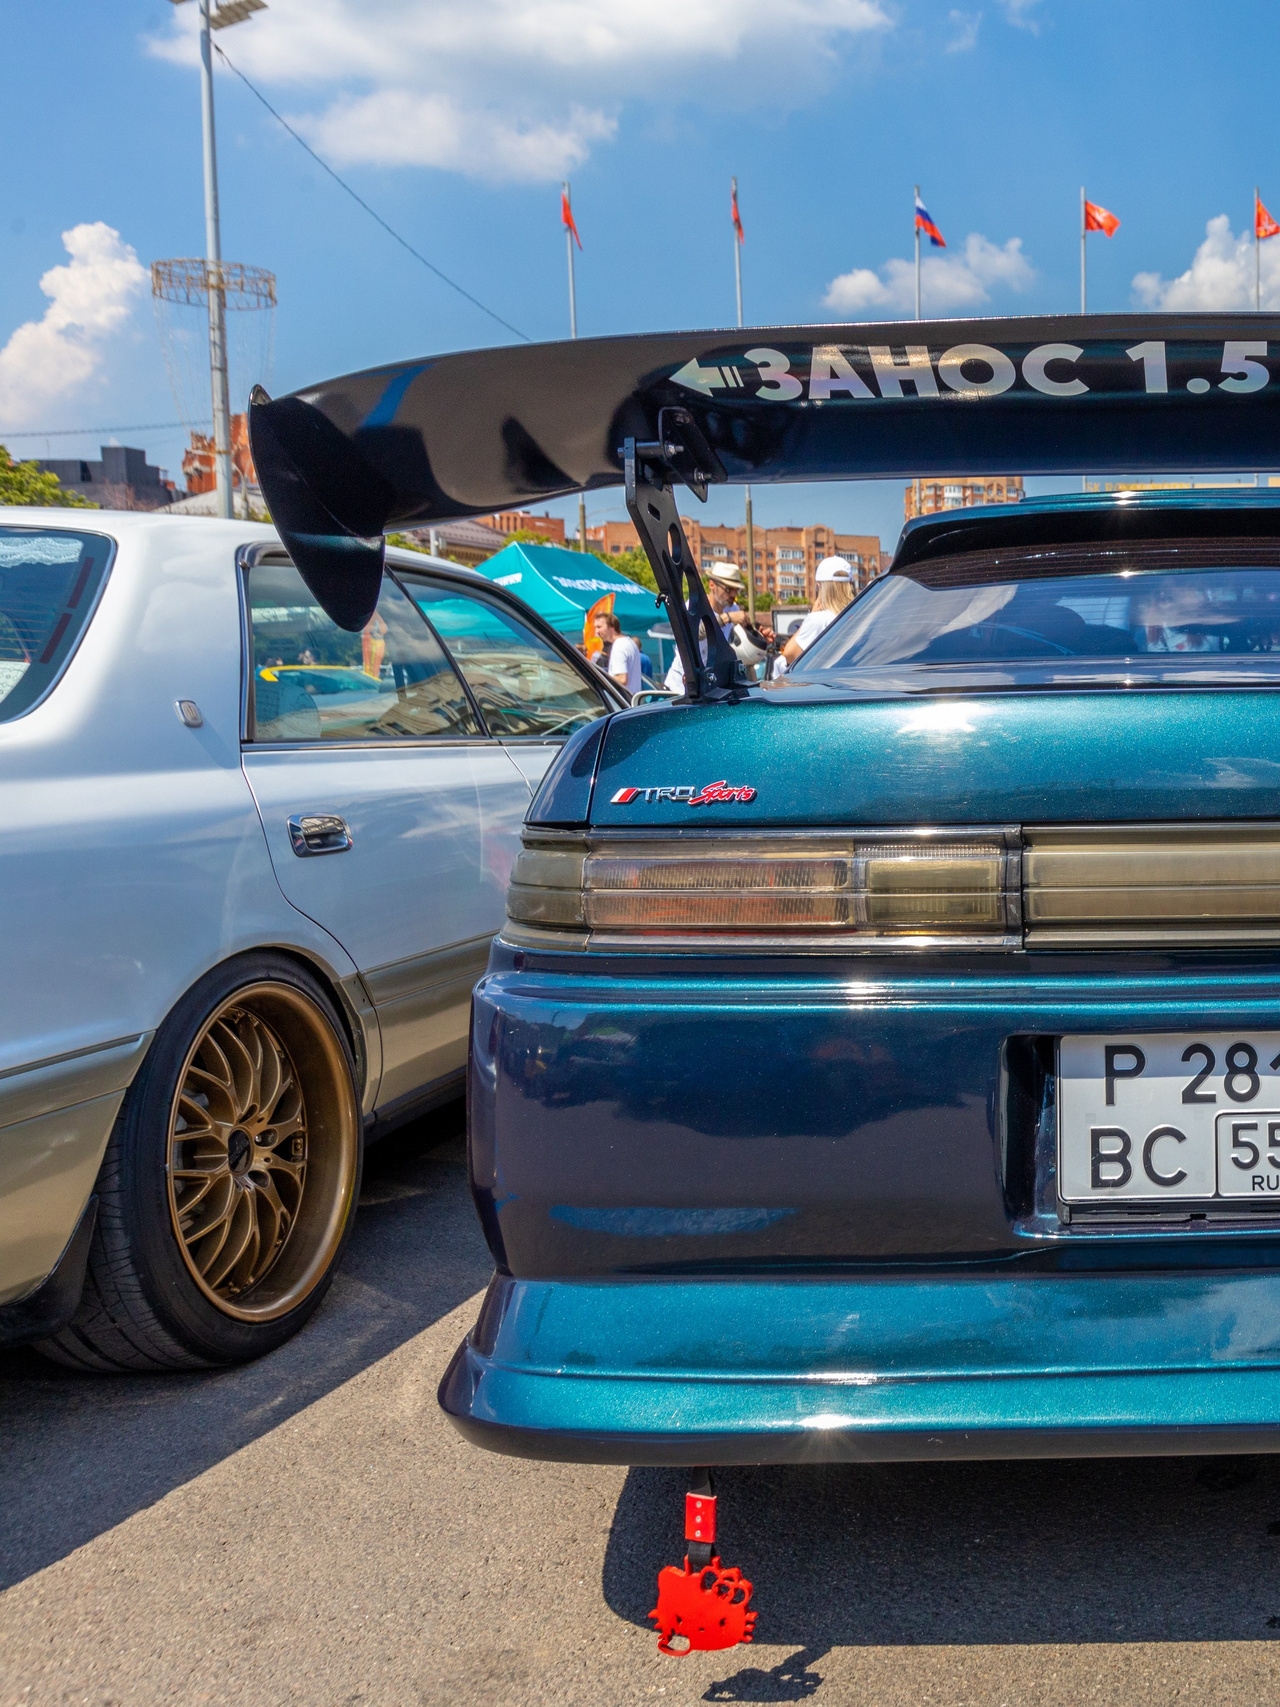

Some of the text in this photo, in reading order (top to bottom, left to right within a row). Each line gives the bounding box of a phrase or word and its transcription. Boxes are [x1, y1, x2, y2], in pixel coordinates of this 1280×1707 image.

[743, 343, 1090, 401] ЗАНОС
[1125, 341, 1271, 394] 1.5
[637, 780, 757, 806] TRD Sports
